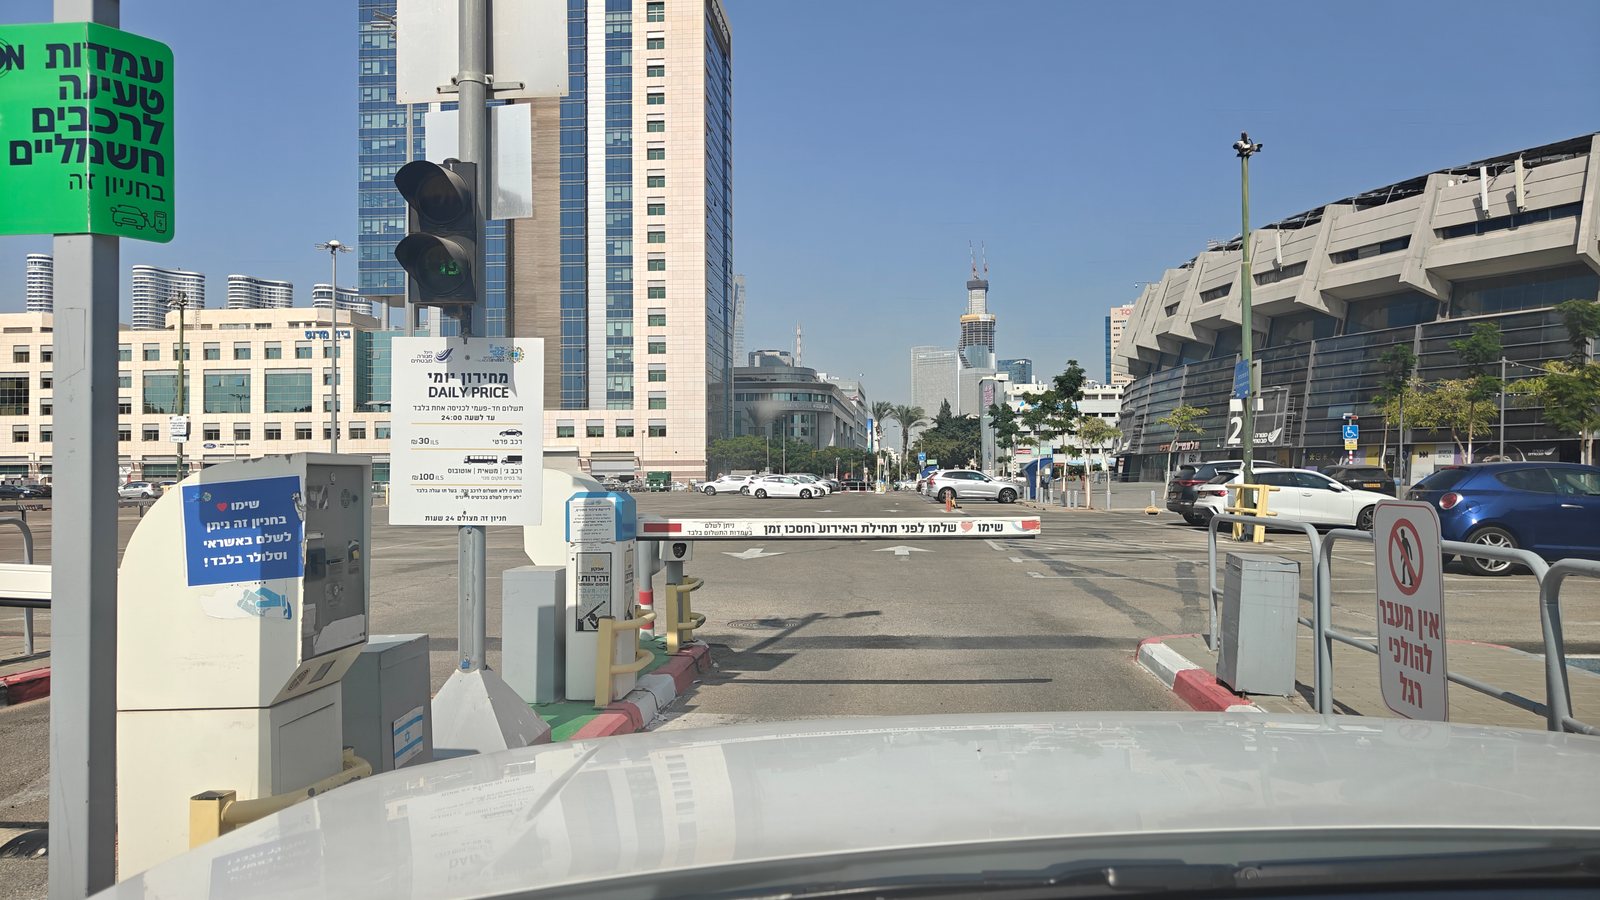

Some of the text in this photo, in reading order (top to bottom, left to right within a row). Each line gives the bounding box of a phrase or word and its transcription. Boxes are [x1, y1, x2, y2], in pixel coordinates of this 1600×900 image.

[46, 42, 164, 84] עמדות
[59, 74, 164, 114] טעינה
[32, 106, 164, 145] לרכבים
[10, 133, 164, 176] חשמליים
[69, 174, 166, 202] בחניון זה
[428, 372, 508, 386] מחירון יומי
[428, 386, 509, 398] DAILY PRICE
[1228, 416, 1242, 444] 2
[231, 500, 260, 510] שימו
[206, 516, 286, 533] בחניון זה ניתן
[764, 522, 1004, 535] שימו שלמו לפני תחילת האירוע וחסכו זמן
[204, 532, 292, 548] לשלם באשראי
[204, 552, 288, 568] וסלולר בלבד!
[1380, 599, 1440, 640] אין מעבר
[1388, 636, 1432, 675] להולכי
[1400, 671, 1422, 709] רגל
